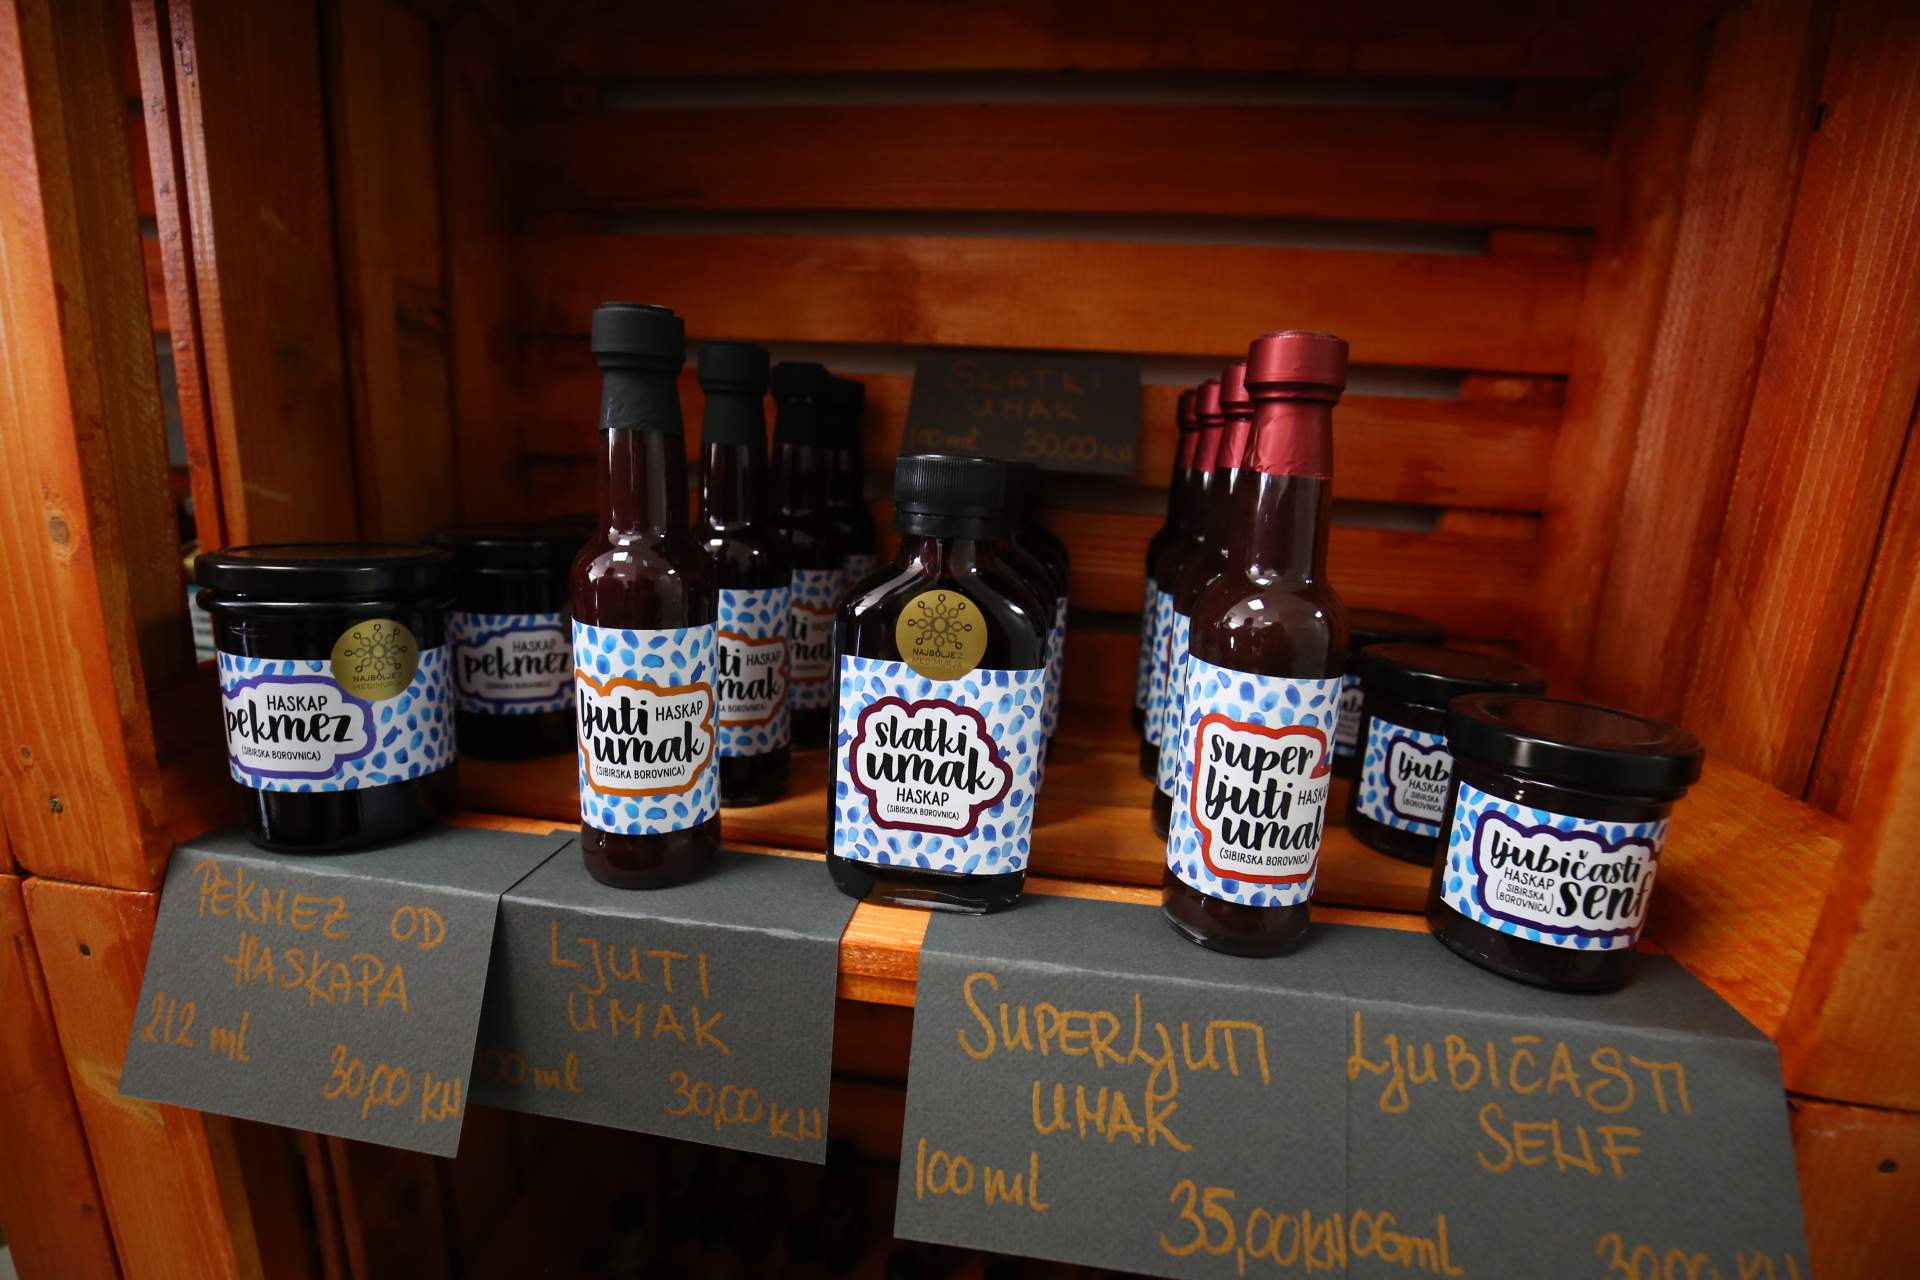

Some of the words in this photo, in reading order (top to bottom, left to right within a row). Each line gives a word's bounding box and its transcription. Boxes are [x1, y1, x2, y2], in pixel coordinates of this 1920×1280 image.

[944, 359, 1102, 394] SLATKI
[968, 397, 1077, 420] UMAK
[464, 646, 569, 684] pekmez
[512, 639, 556, 652] HASKAP
[746, 650, 781, 666] HASKAP
[912, 648, 955, 659] NAJBOLJE
[353, 672, 396, 682] NAJBOLJE
[717, 667, 780, 700] mak
[225, 699, 354, 744] pekmez
[267, 695, 328, 712] HASKAP
[580, 688, 648, 740] ljuti
[656, 700, 703, 721] HASKAP
[241, 745, 271, 759] (SIBIRSKA
[272, 750, 321, 762] BOROVNICA)
[594, 721, 704, 766] umak
[875, 715, 967, 757] slatki
[596, 765, 632, 779] (SIBIRSKA
[634, 765, 685, 779] BOROVNICA)
[866, 747, 995, 795] umak
[1210, 734, 1314, 785] super
[896, 787, 950, 807] HASKAP
[1205, 765, 1294, 820] ljuti
[1409, 779, 1447, 795] HASKAP
[886, 803, 918, 815] (SIBIRSKA
[919, 807, 960, 821] BOROVNICA)
[1221, 805, 1321, 851] umak
[1219, 847, 1263, 866] (SIBIRSKA
[1265, 852, 1310, 867] BOROVNICA)
[1491, 830, 1642, 884] ljubičasti
[1504, 867, 1555, 890] HASKAP
[193, 860, 351, 938] PEKMEZ
[390, 905, 446, 948] OD
[1556, 871, 1652, 921] senf
[223, 933, 409, 1014] HASKAPA
[550, 920, 710, 1000] LJUTI
[139, 991, 196, 1047] 212
[567, 992, 731, 1056] UMAK
[323, 1044, 411, 1120] 30,00
[663, 1071, 763, 1131] 30,00
[1032, 1080, 1193, 1152] UMAK
[1477, 1102, 1642, 1179] SENF
